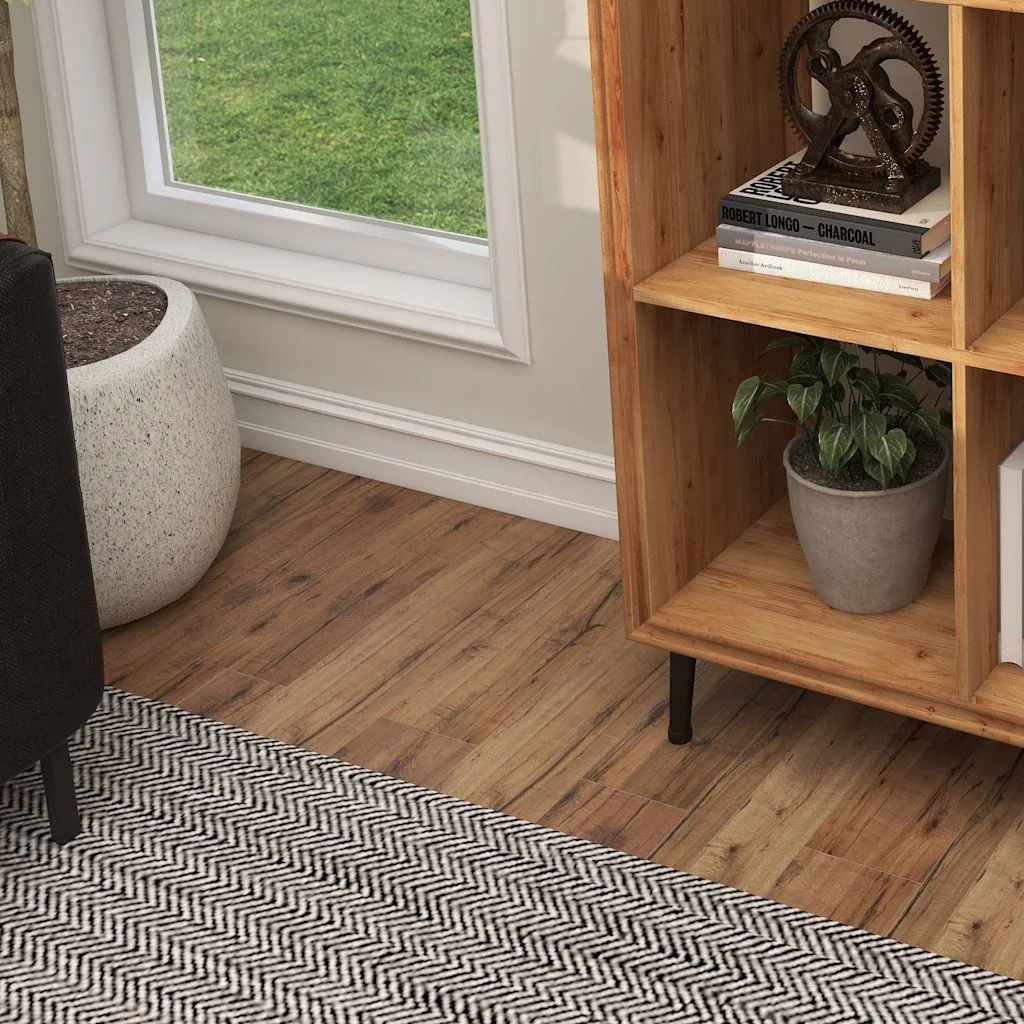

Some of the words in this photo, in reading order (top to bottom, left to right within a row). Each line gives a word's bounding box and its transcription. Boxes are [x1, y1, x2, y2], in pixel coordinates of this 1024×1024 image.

[721, 206, 763, 226] ROBERT
[765, 213, 800, 233] LONGO
[818, 222, 876, 246] CHARCOAL
